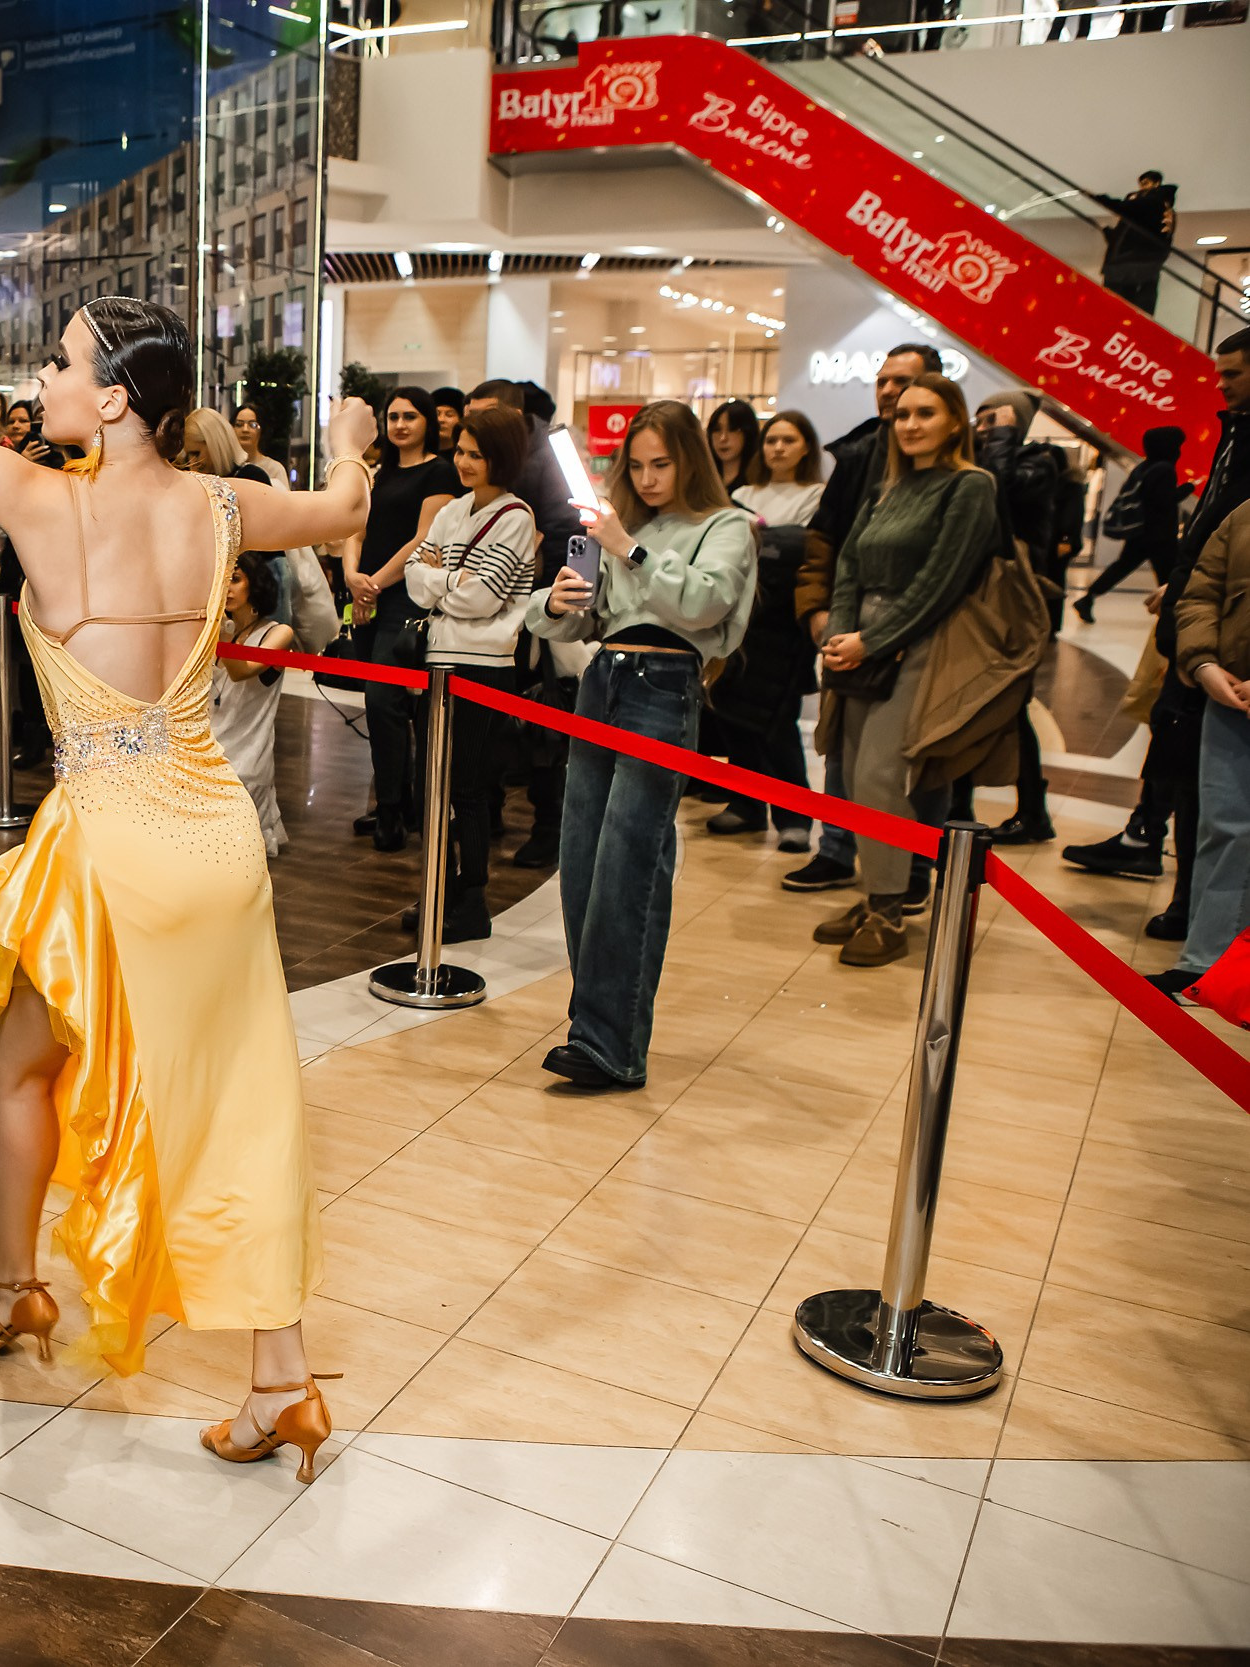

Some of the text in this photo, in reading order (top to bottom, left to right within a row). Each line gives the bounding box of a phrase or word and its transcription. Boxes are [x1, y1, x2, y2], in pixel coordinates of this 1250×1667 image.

[498, 88, 586, 129] Batyr
[570, 105, 615, 127] mall
[687, 91, 814, 170] Вместе
[747, 94, 809, 147] Бірге
[845, 189, 936, 264] Batyr
[901, 259, 948, 293] mall
[810, 349, 970, 385] MAO
[1034, 325, 1177, 411] Вместе
[1103, 331, 1173, 388] Бірге
